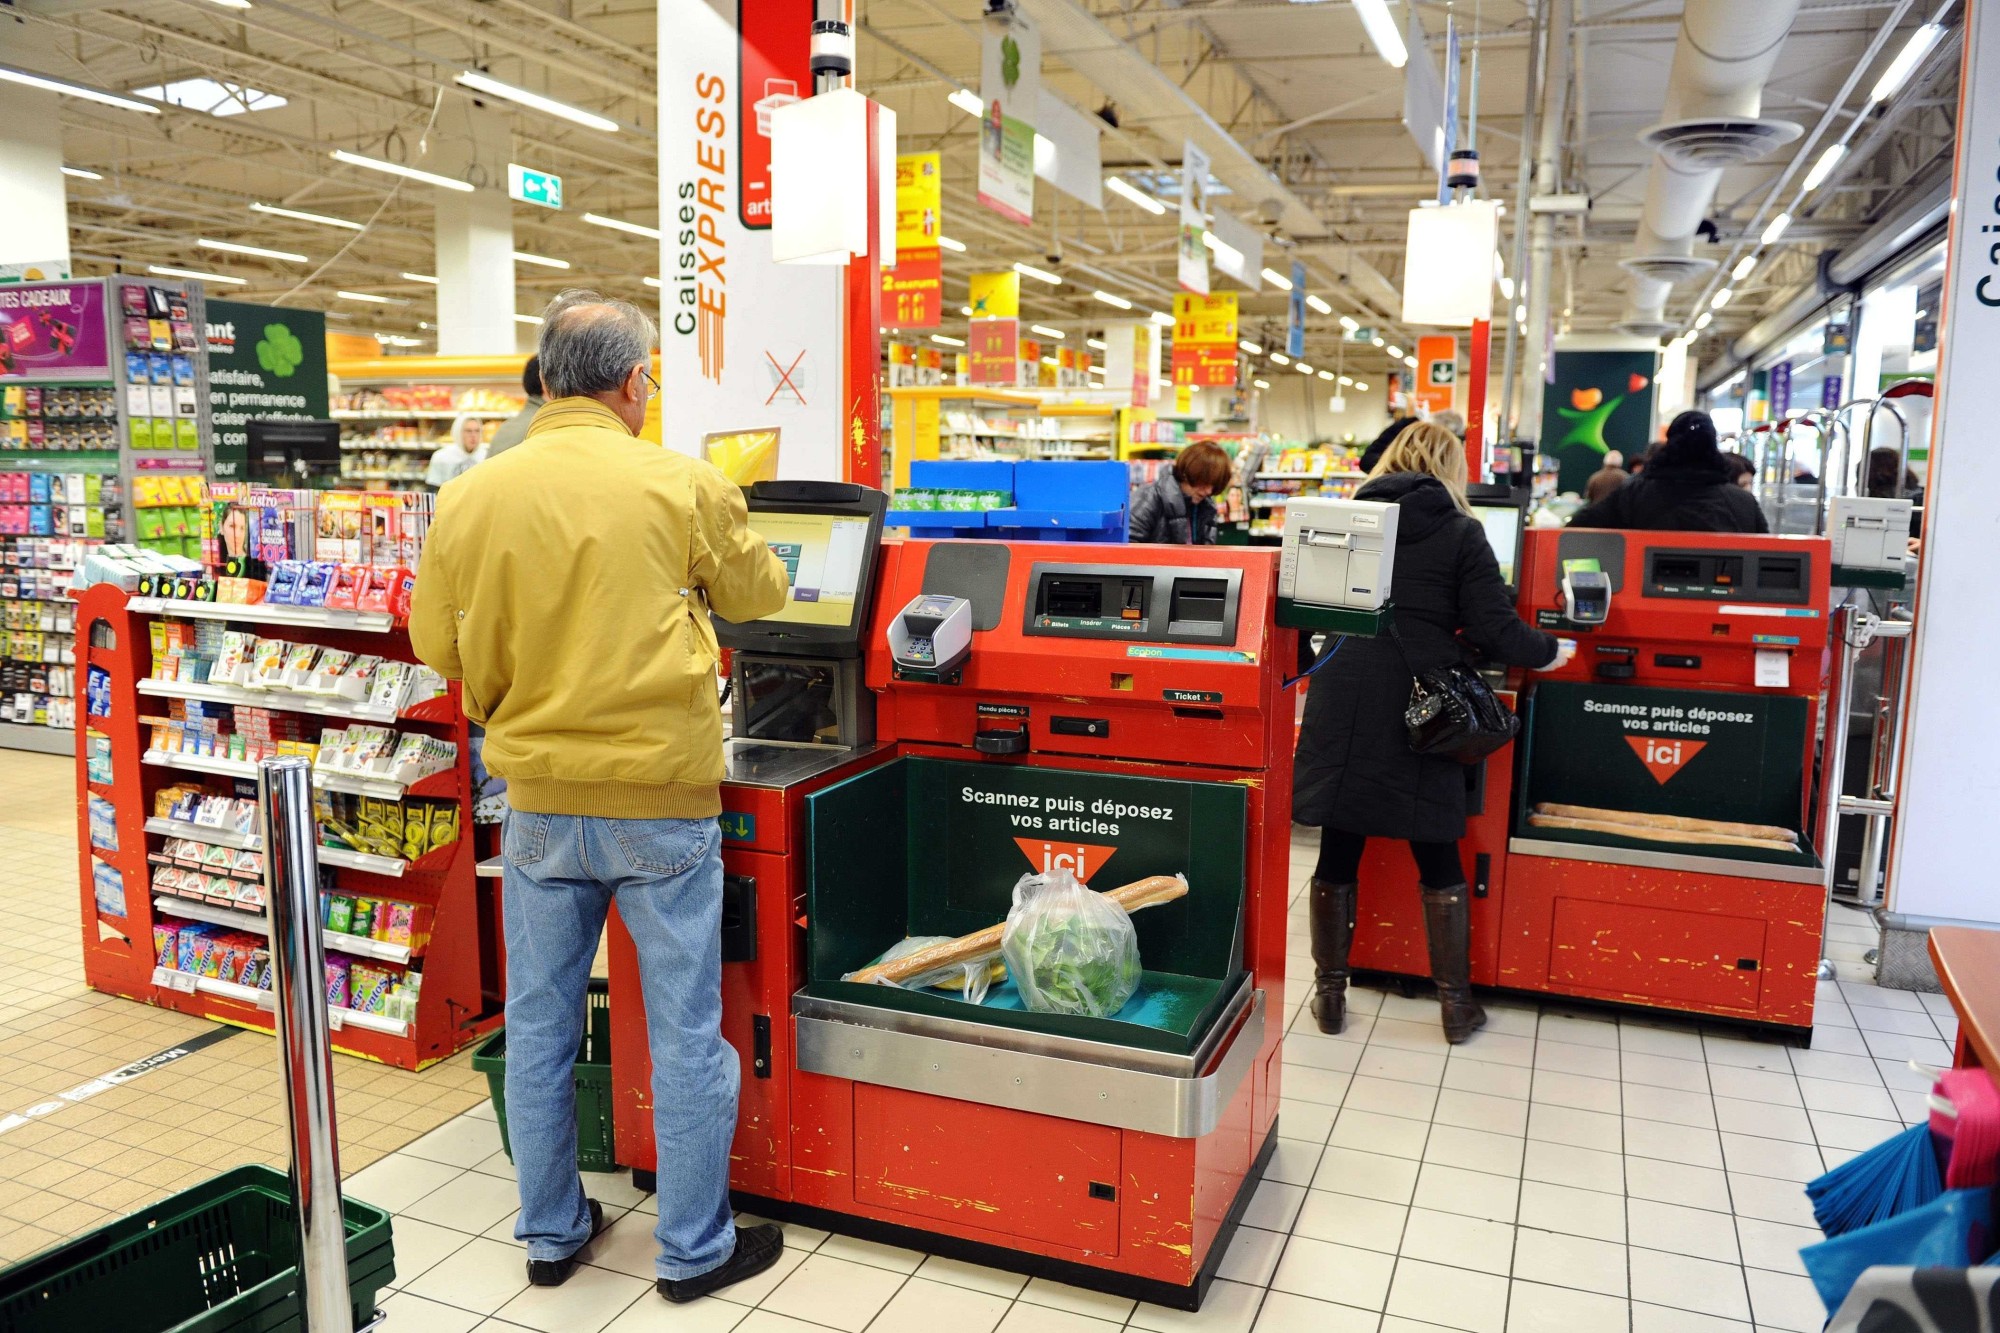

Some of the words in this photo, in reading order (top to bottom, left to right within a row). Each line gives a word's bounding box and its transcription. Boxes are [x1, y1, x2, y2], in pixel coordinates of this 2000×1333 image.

[696, 72, 726, 318] EXPRESS
[674, 181, 696, 335] Caisses
[20, 288, 72, 308] CADEAUX
[209, 391, 227, 405] en
[229, 391, 307, 409] permanence
[256, 545, 287, 562] 2012
[1051, 621, 1070, 629] Billets
[1174, 692, 1201, 702] Ticket
[978, 705, 998, 713] Rendu
[997, 707, 1018, 715] pièces
[1583, 699, 1648, 717] Scannez
[1650, 706, 1684, 719] puis
[1687, 707, 1754, 723] déposez
[1622, 719, 1649, 730] vos
[1652, 721, 1711, 735] articles
[1646, 740, 1682, 765] ici
[961, 786, 1040, 809] Scannez
[1045, 796, 1085, 812] puis
[1091, 799, 1174, 821] déposez
[1010, 814, 1043, 828] vos
[1048, 817, 1120, 836] articles
[1043, 844, 1086, 879] ici
